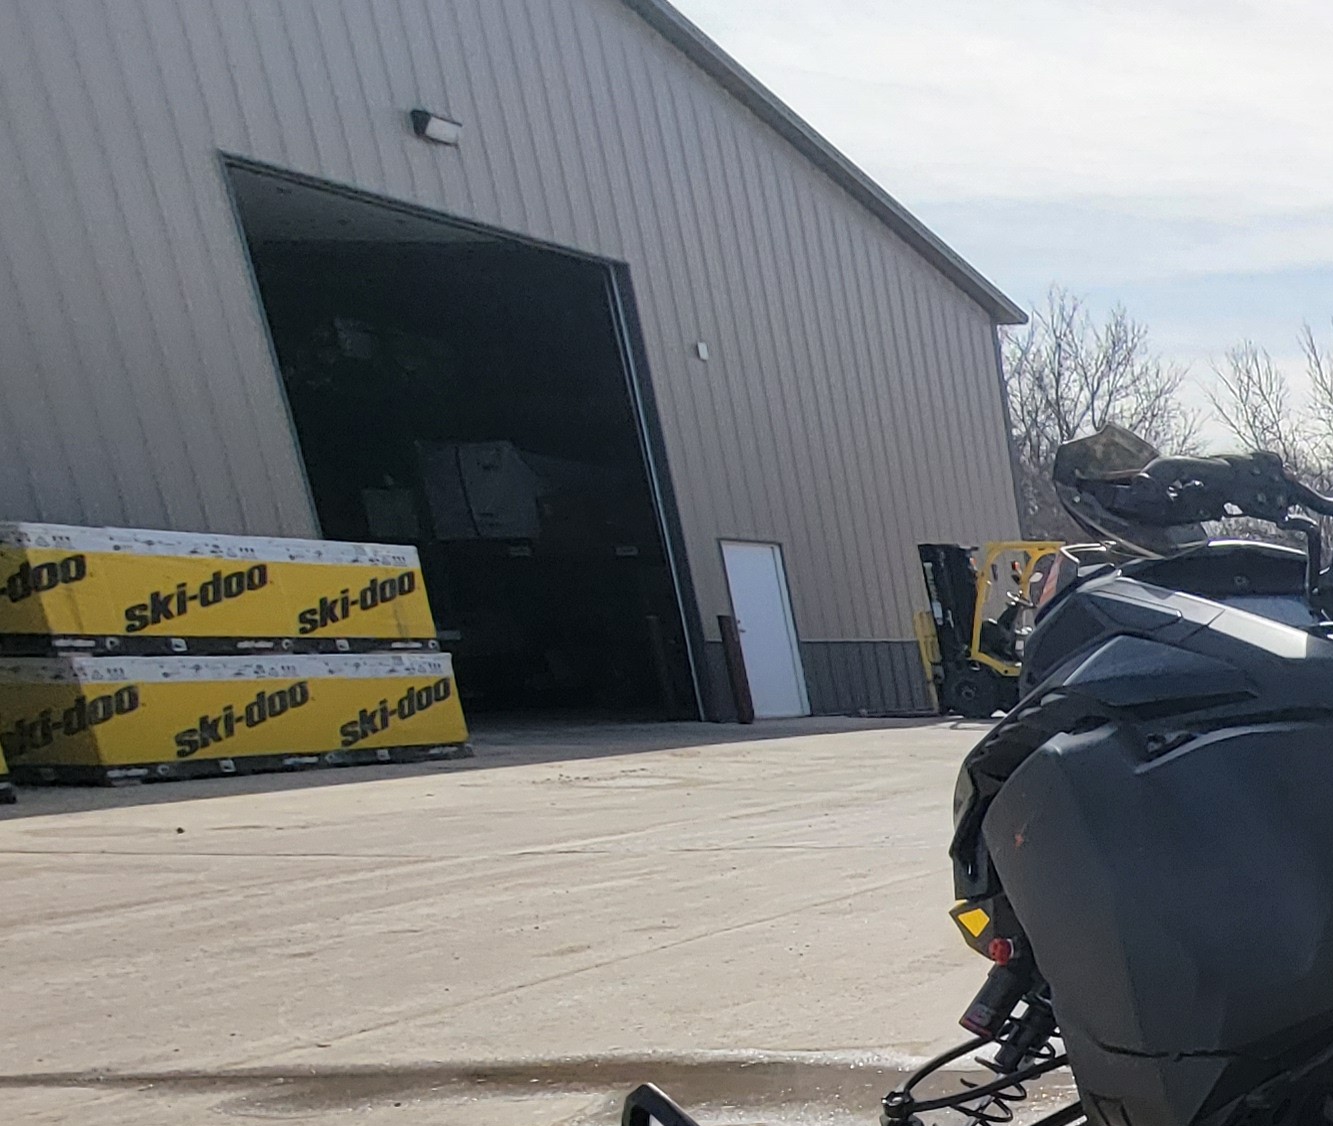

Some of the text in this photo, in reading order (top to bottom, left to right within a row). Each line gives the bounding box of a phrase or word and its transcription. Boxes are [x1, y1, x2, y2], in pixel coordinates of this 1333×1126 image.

[125, 564, 267, 633] ski-doo
[298, 571, 415, 634] ski-doo
[174, 681, 309, 757] ski-doo
[339, 677, 450, 747] ski-doo
